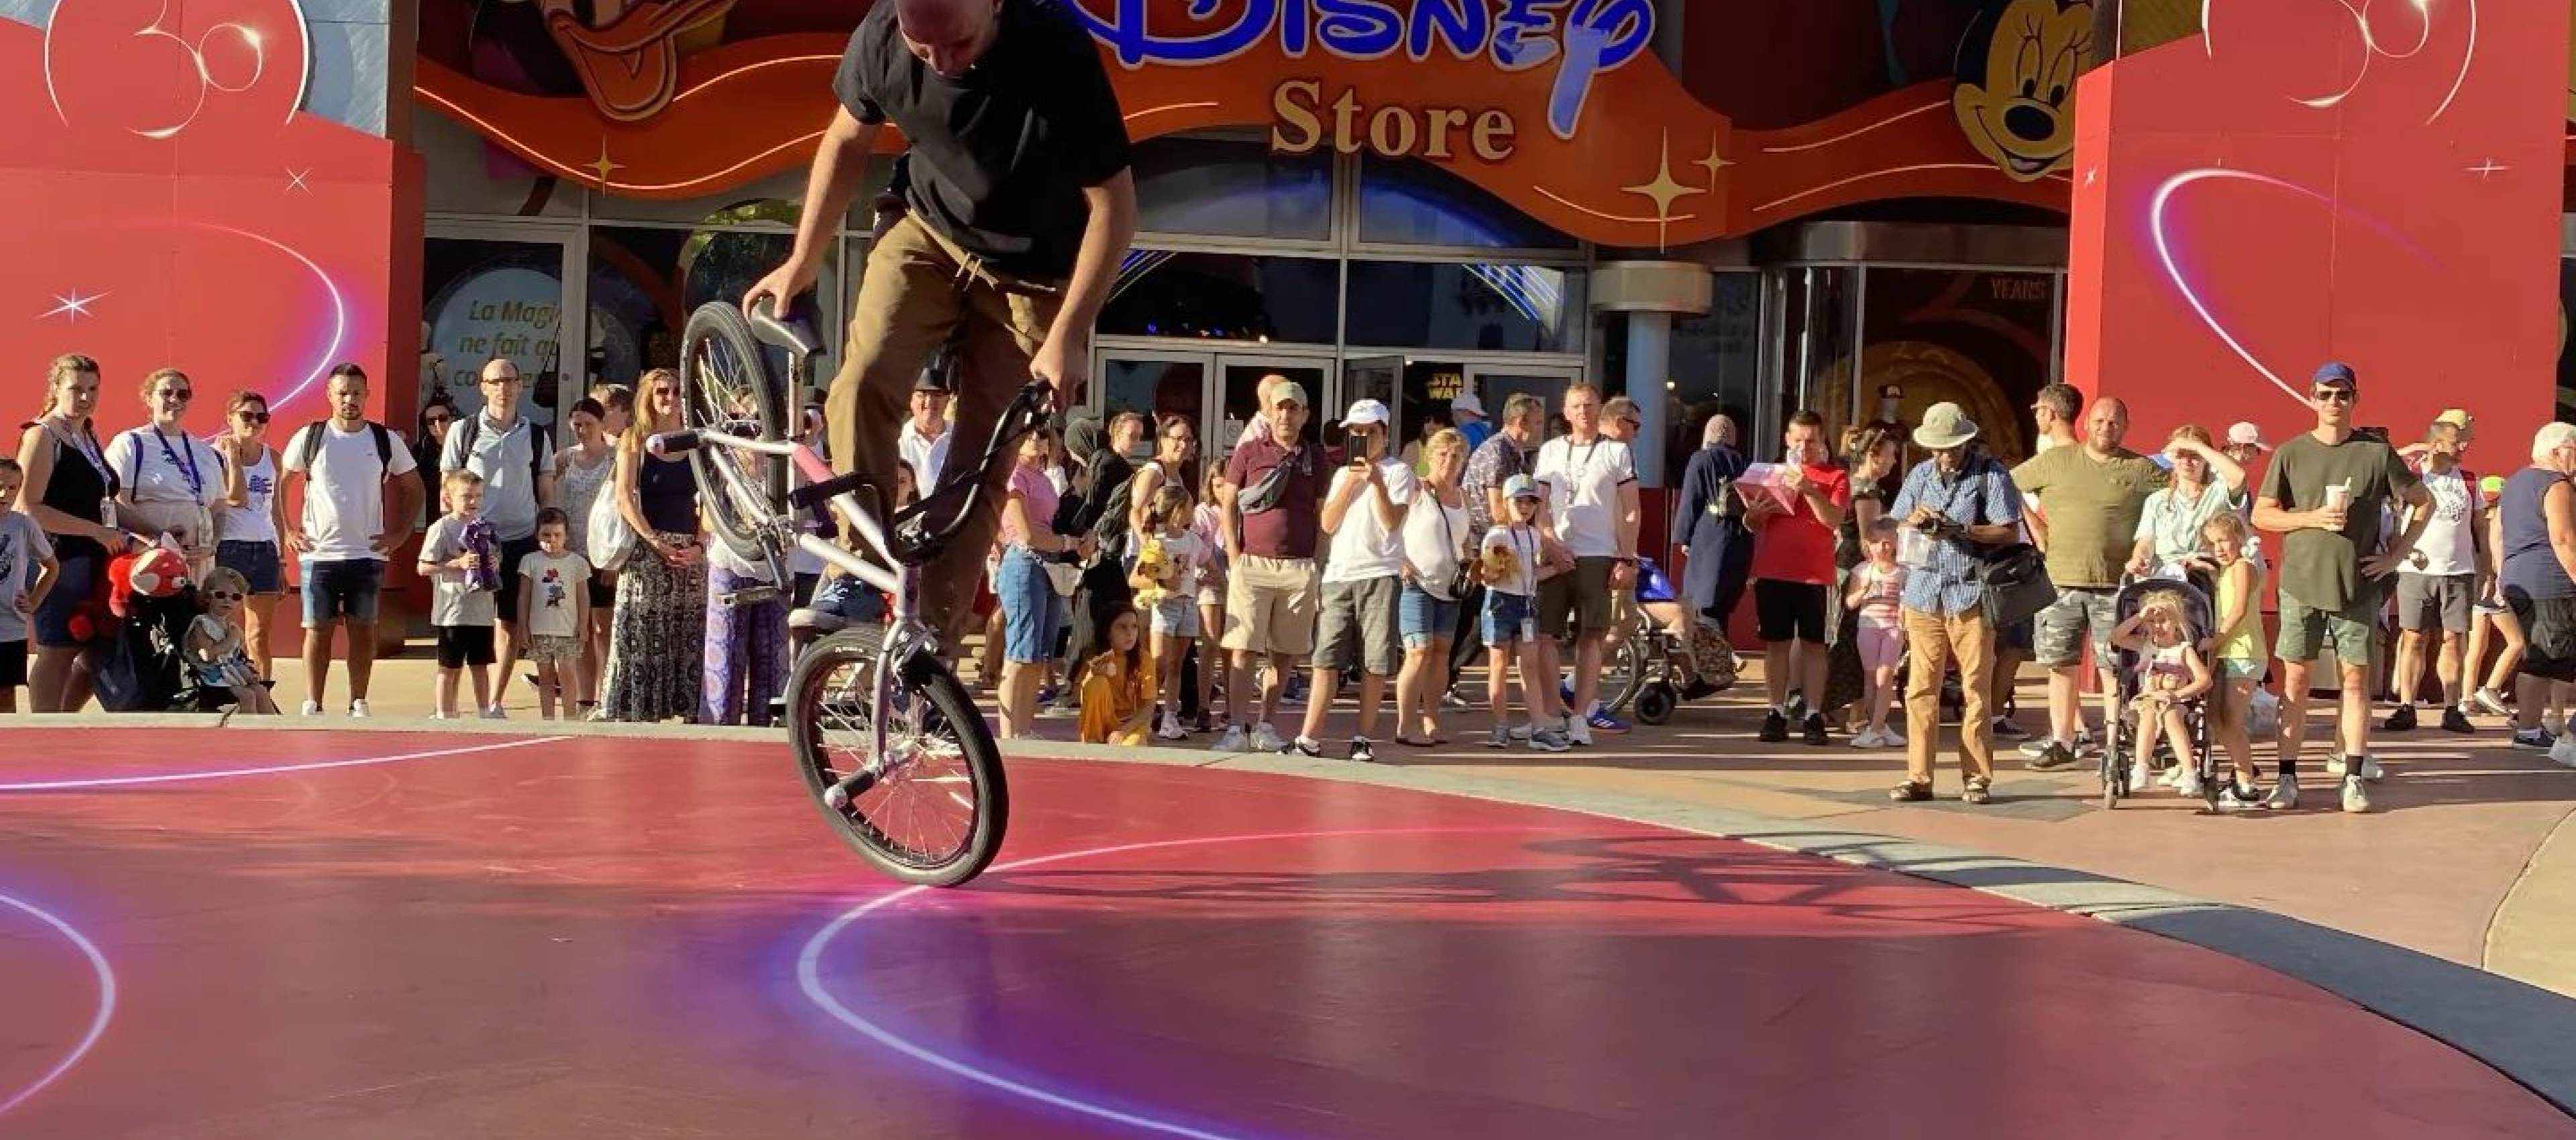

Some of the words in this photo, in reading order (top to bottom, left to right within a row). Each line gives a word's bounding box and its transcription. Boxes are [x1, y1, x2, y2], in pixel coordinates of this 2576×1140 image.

[1271, 80, 1514, 160] Store
[469, 300, 495, 321] La
[501, 300, 560, 329] Magi
[460, 337, 487, 355] ne
[490, 332, 529, 360] fait
[1427, 373, 1463, 387] STA
